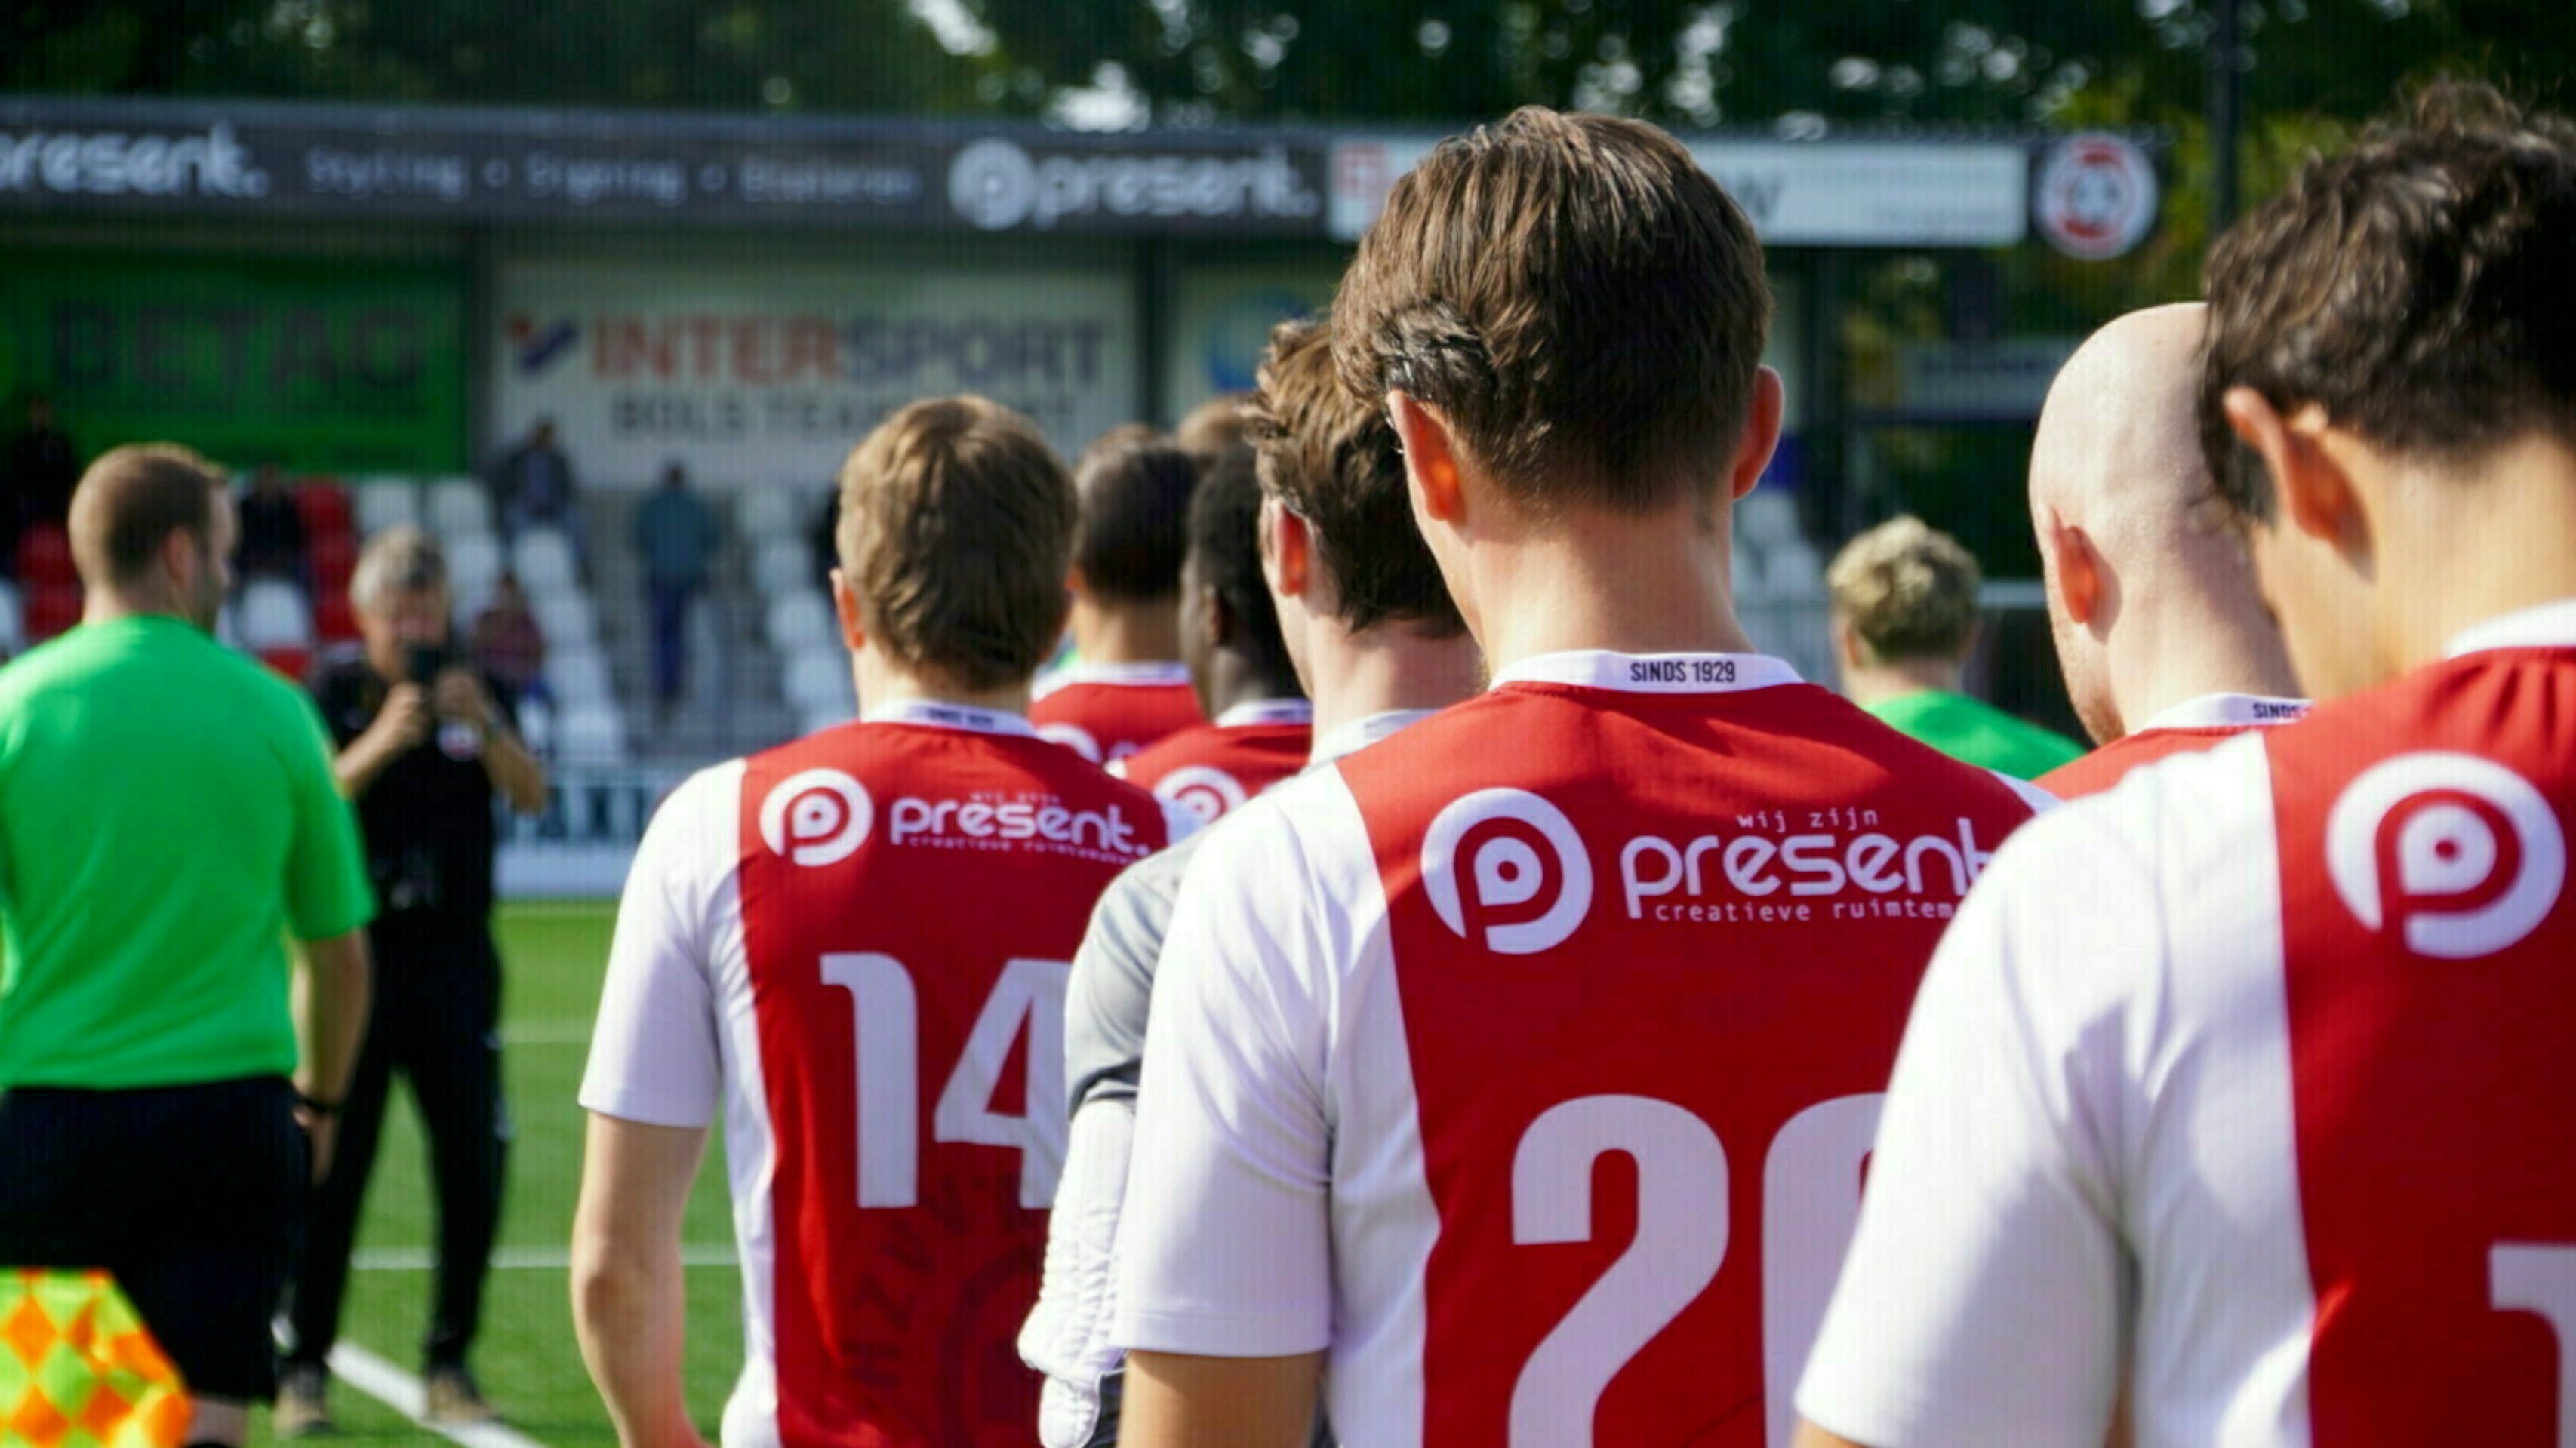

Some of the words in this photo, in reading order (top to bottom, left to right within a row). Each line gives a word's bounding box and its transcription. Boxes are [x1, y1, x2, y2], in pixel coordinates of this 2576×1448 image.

[1630, 660, 1687, 683] SINDS
[1691, 660, 1735, 683] 1929
[1736, 810, 1786, 833] wij
[1808, 807, 1878, 832] zijn
[1655, 901, 1810, 922] creatieve
[1833, 899, 1956, 919] ruimtem
[820, 951, 1072, 1209] 14
